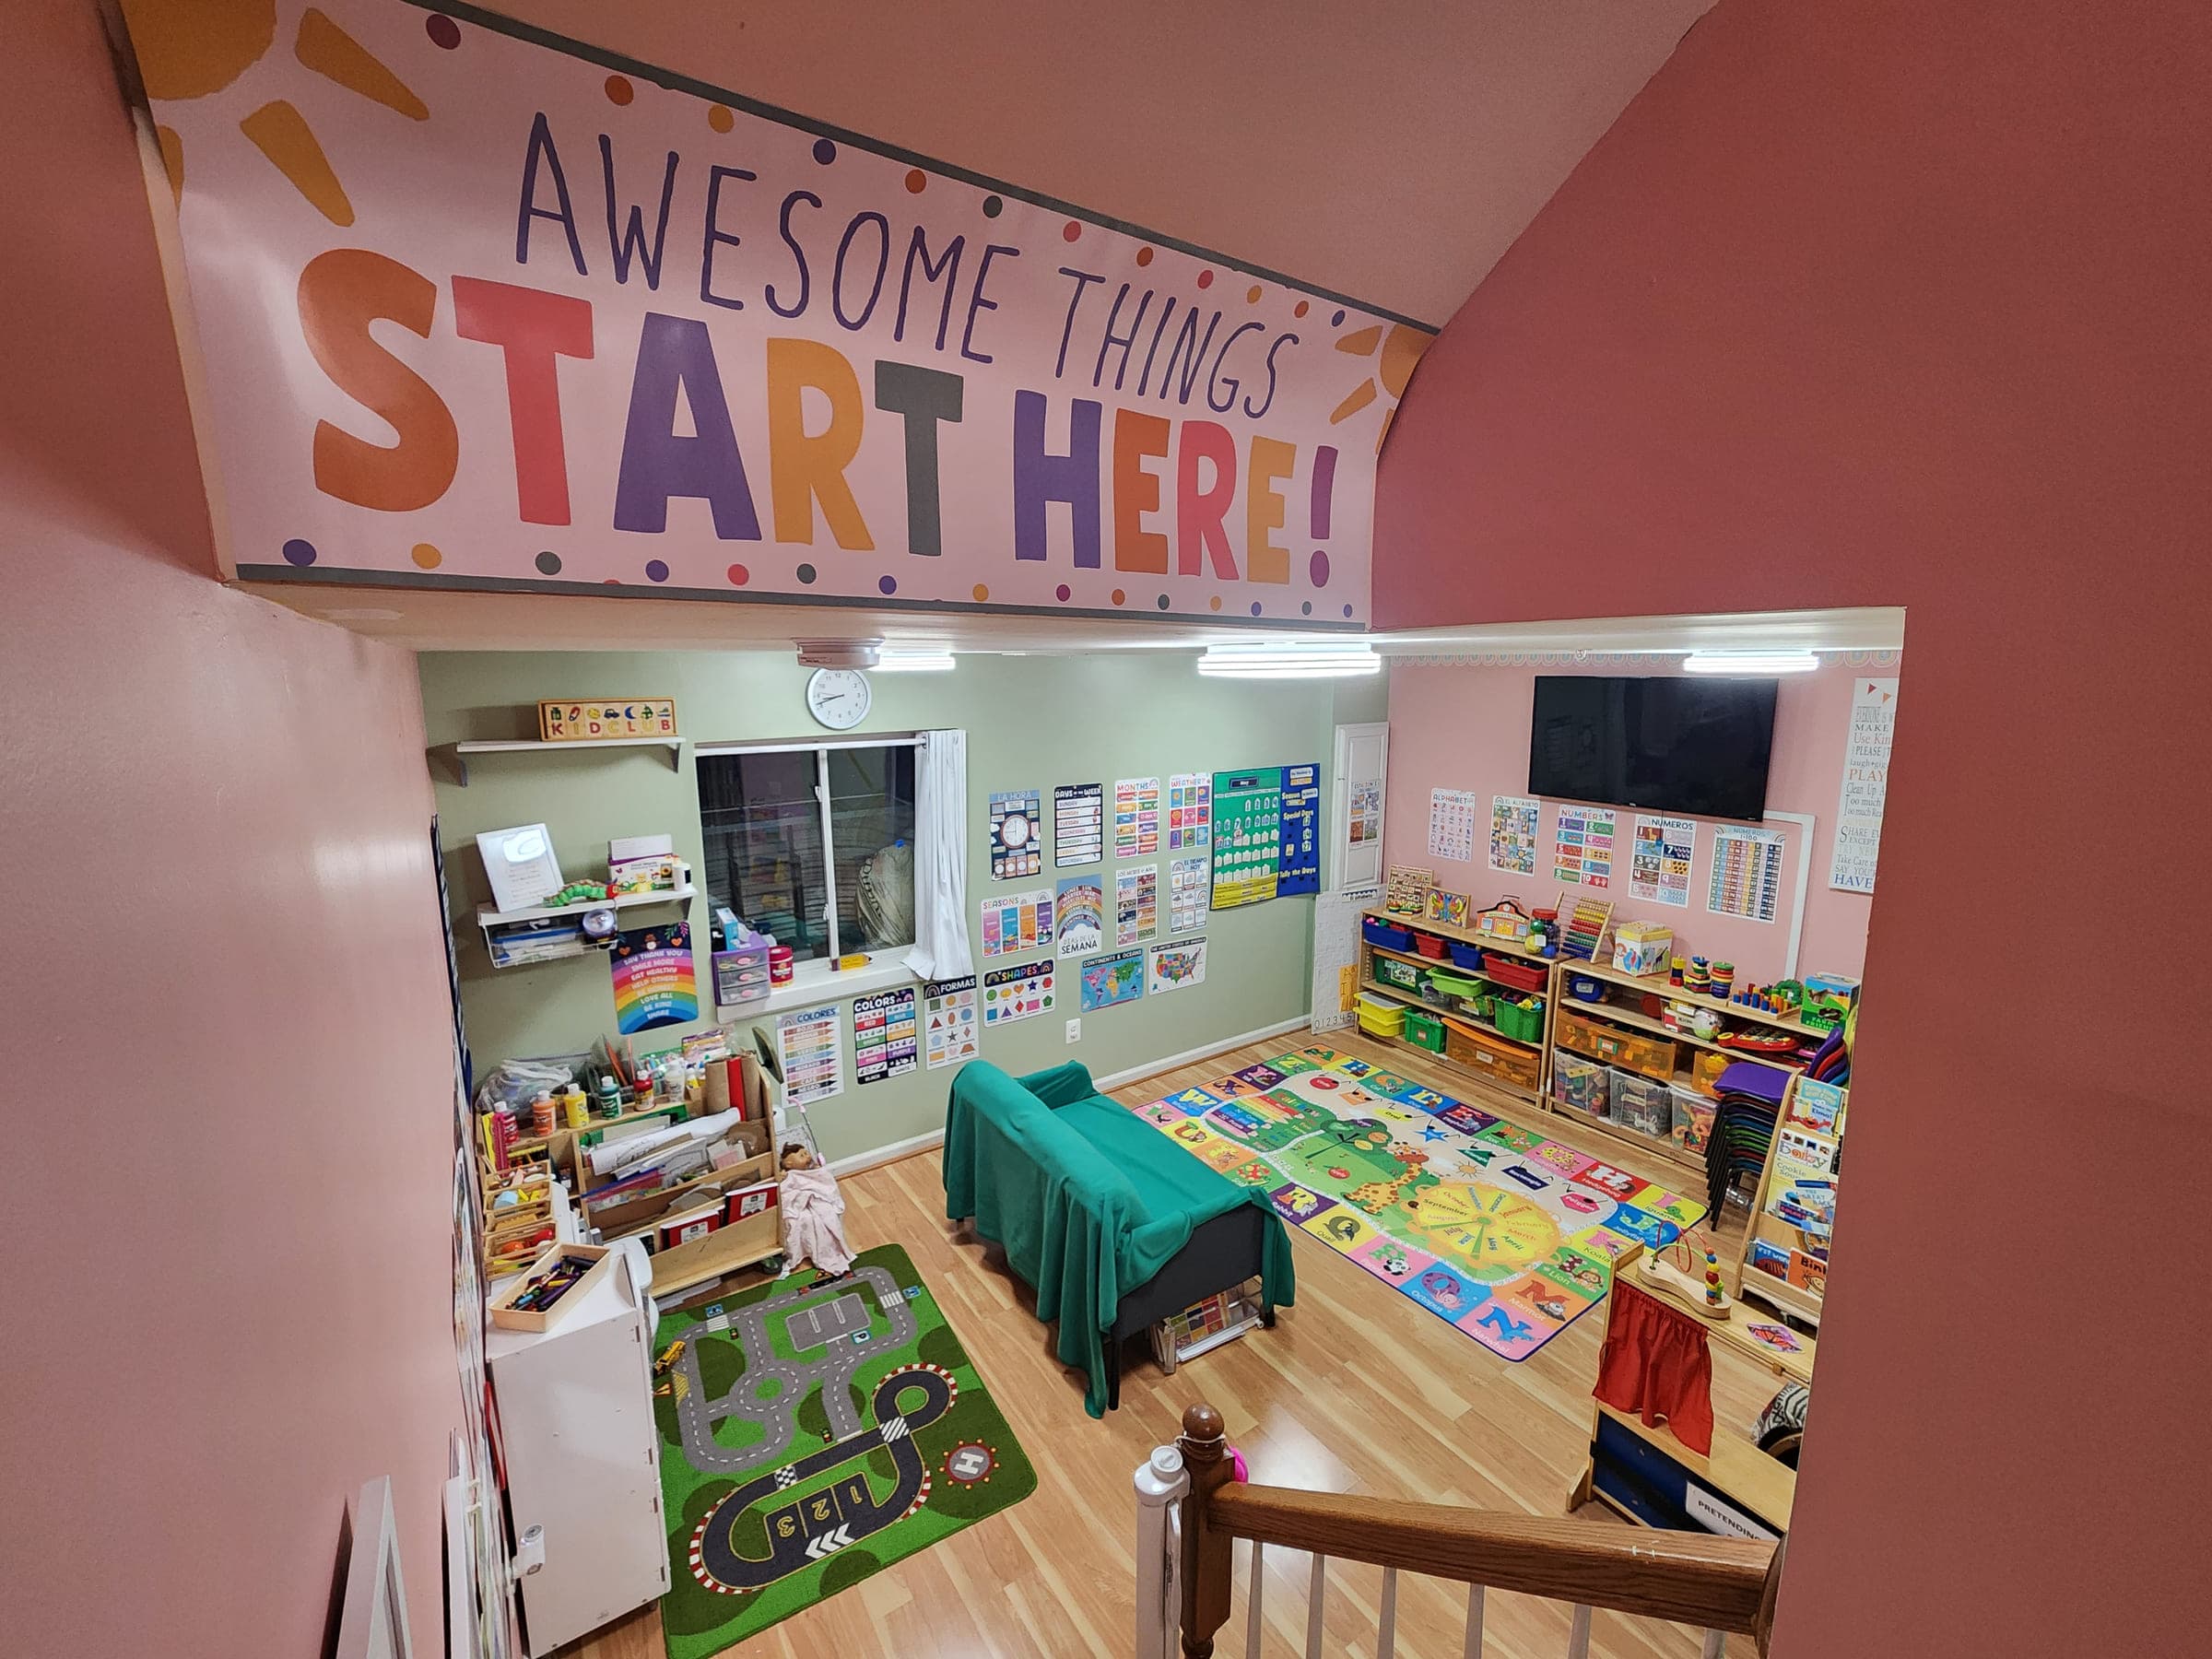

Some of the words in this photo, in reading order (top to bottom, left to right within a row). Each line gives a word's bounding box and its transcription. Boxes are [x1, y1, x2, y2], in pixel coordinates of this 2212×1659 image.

[514, 111, 1021, 363] AWESOME
[1054, 265, 1300, 418] THINGS
[296, 248, 963, 556] START
[1011, 389, 1339, 587] HERE!
[1854, 724, 1888, 732] MAKE
[1849, 769, 1886, 782] PLAY
[1055, 790, 1073, 799] DAYS
[1117, 782, 1148, 792] MONTHS
[1432, 794, 1467, 805] ALPHABET
[1561, 808, 1604, 821] NUMBERS
[1640, 827, 1643, 835] 1
[1637, 841, 1643, 850] 2
[1667, 845, 1674, 854] 7
[1636, 855, 1642, 865] 3
[1634, 869, 1641, 878] 4
[1834, 873, 1873, 889] HAVE
[982, 897, 1019, 910] SEASONS
[641, 950, 665, 960] THANK
[1062, 940, 1098, 955] SEMANA
[653, 958, 675, 967] MORE
[1083, 956, 1116, 967] CONTINENTS
[1122, 949, 1142, 959] OCEANS
[630, 971, 645, 982] EAT
[646, 967, 677, 976] HEALTHY
[1002, 965, 1038, 982] SHAPES
[940, 978, 975, 994] FORMAS
[640, 994, 659, 1005] LOVE
[854, 995, 896, 1012] COLORS
[796, 1007, 837, 1023] COLORES
[1779, 1140, 1829, 1169] baby
[1508, 1169, 1542, 1187] Rectangle
[1776, 1162, 1807, 1178] Cookie
[1582, 1178, 1622, 1198] Hedgehog
[1423, 1198, 1468, 1217] September
[1316, 1230, 1336, 1242] Quail
[1500, 1233, 1524, 1251] April
[1583, 1246, 1611, 1263] Koala
[1547, 1269, 1571, 1286] Lion
[1515, 1279, 1571, 1306] M
[1410, 1288, 1444, 1314] Octopus
[1508, 1297, 1547, 1322] Marmot
[1476, 1305, 1534, 1341] N
[1470, 1327, 1511, 1354] Narwhal
[955, 1451, 983, 1476] H
[849, 1485, 863, 1504] 1
[811, 1498, 830, 1521] 2
[776, 1515, 796, 1537] 3
